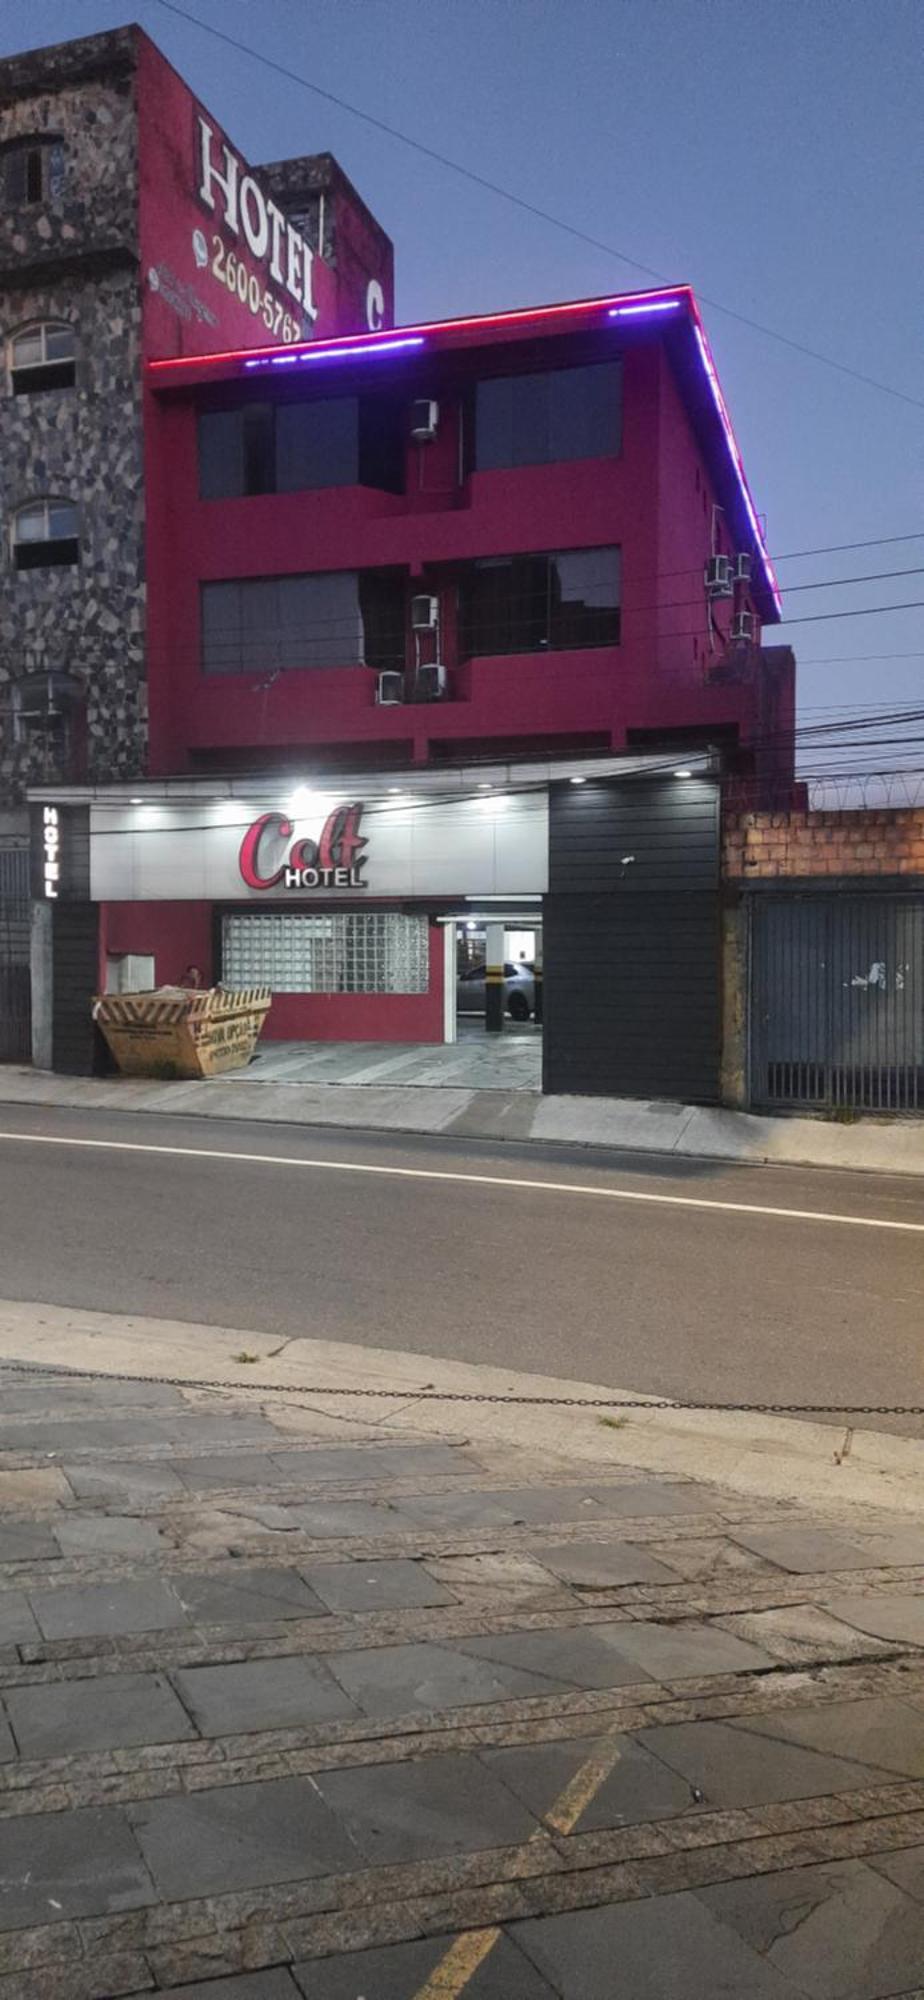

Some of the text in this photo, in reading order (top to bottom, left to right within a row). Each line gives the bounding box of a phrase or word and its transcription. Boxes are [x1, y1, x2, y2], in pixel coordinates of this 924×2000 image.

[198, 115, 318, 321] HOTEL
[43, 806, 59, 898] HOTEL
[239, 801, 369, 890] Colt
[284, 866, 366, 889] HOTEL
